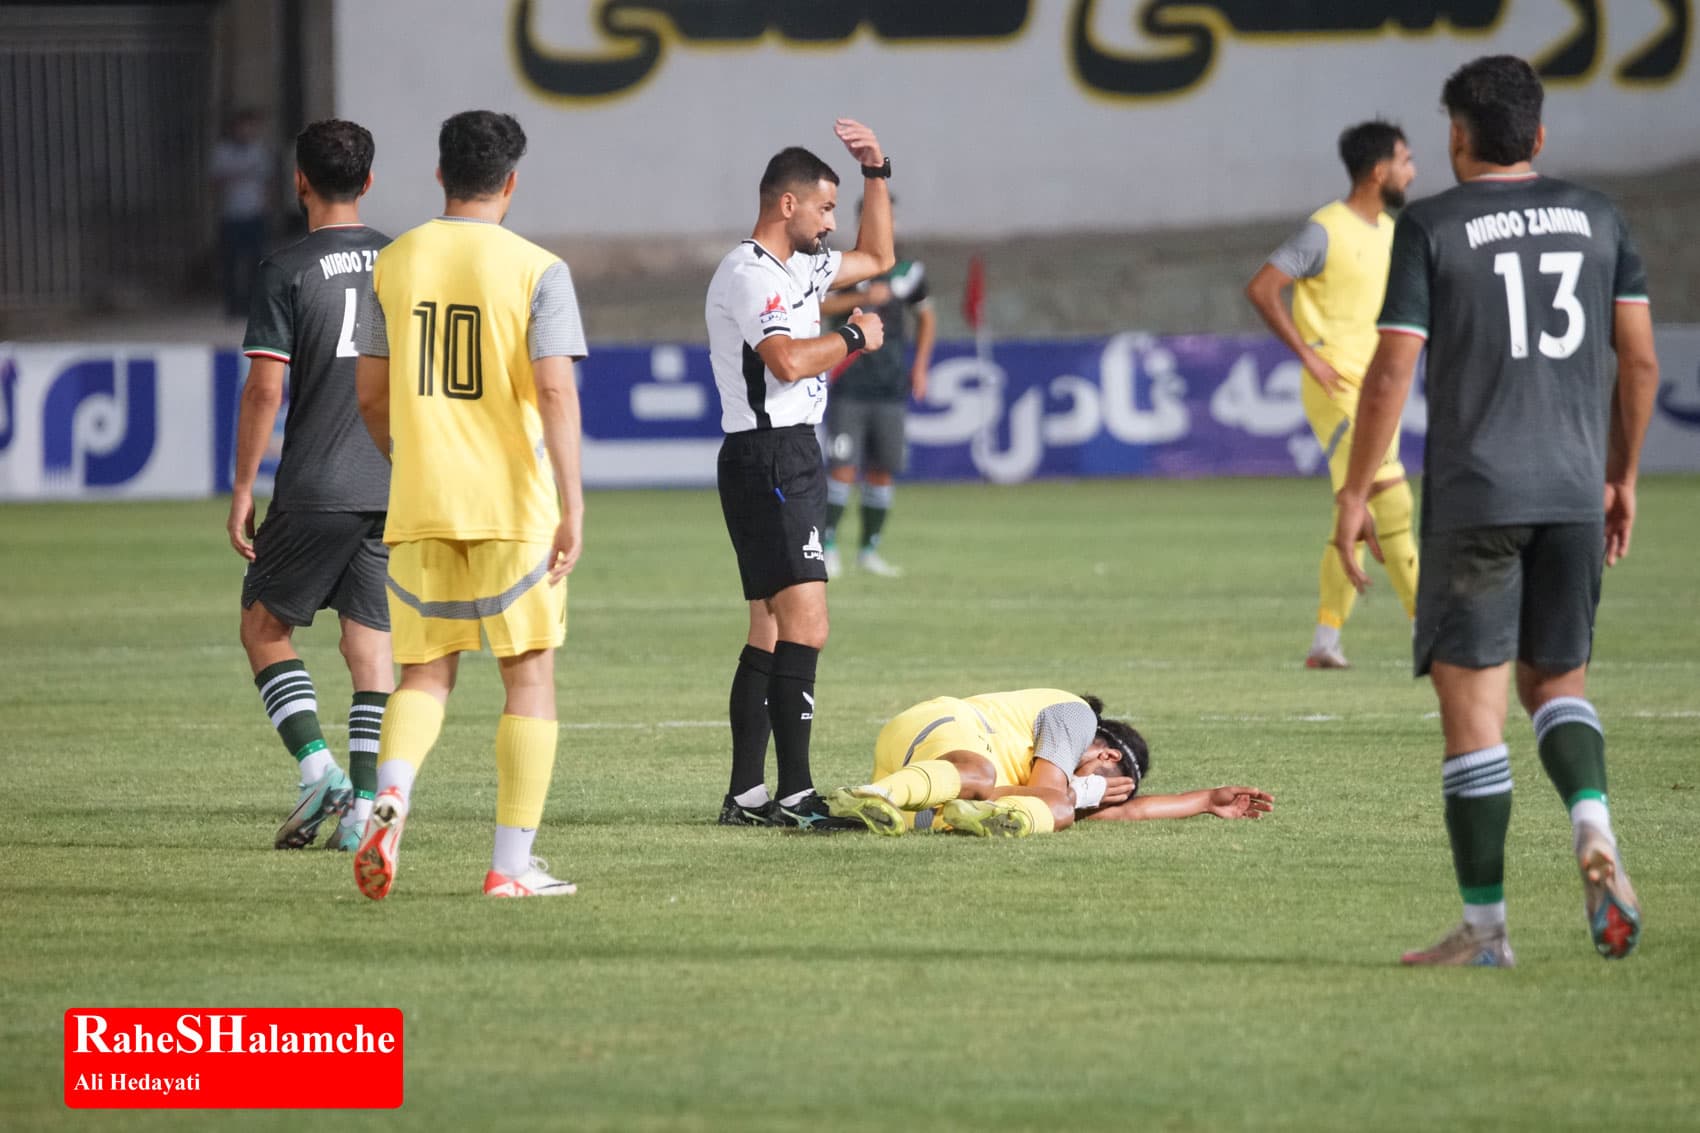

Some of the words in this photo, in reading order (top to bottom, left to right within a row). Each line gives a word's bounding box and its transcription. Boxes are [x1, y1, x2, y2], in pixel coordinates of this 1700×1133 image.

[1465, 210, 1525, 249] NIROO
[1524, 207, 1592, 238] ZAMINI
[319, 250, 362, 280] NIROO
[1493, 251, 1586, 360] 13
[412, 301, 483, 401] 10
